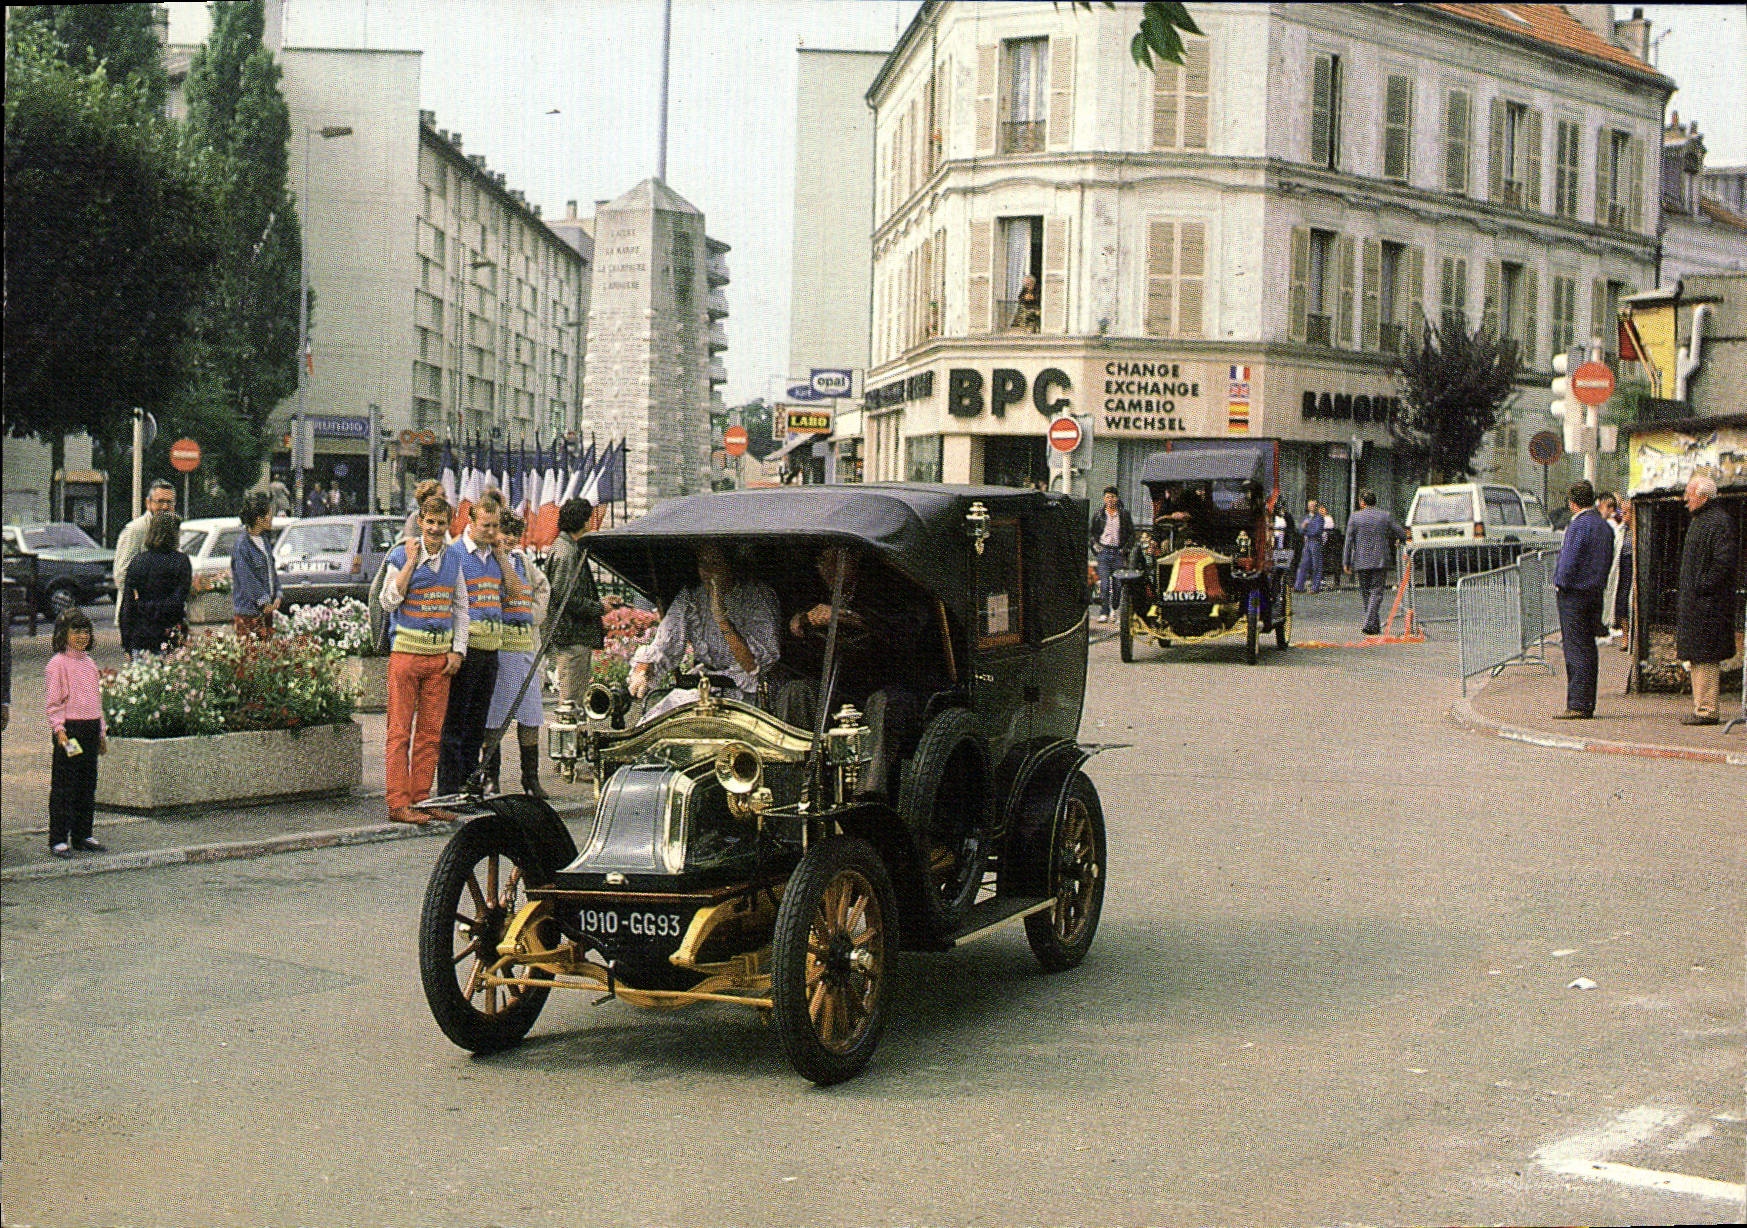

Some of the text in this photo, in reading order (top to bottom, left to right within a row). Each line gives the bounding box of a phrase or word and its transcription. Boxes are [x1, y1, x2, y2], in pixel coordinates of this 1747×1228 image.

[1105, 362, 1180, 378] CHANGE
[948, 367, 1072, 419] BPC
[1104, 380, 1199, 397] EXCHANGE
[1104, 398, 1175, 413] CAMBIO
[1105, 416, 1186, 431] WECHSEL
[578, 909, 681, 937] 1910-GG93
